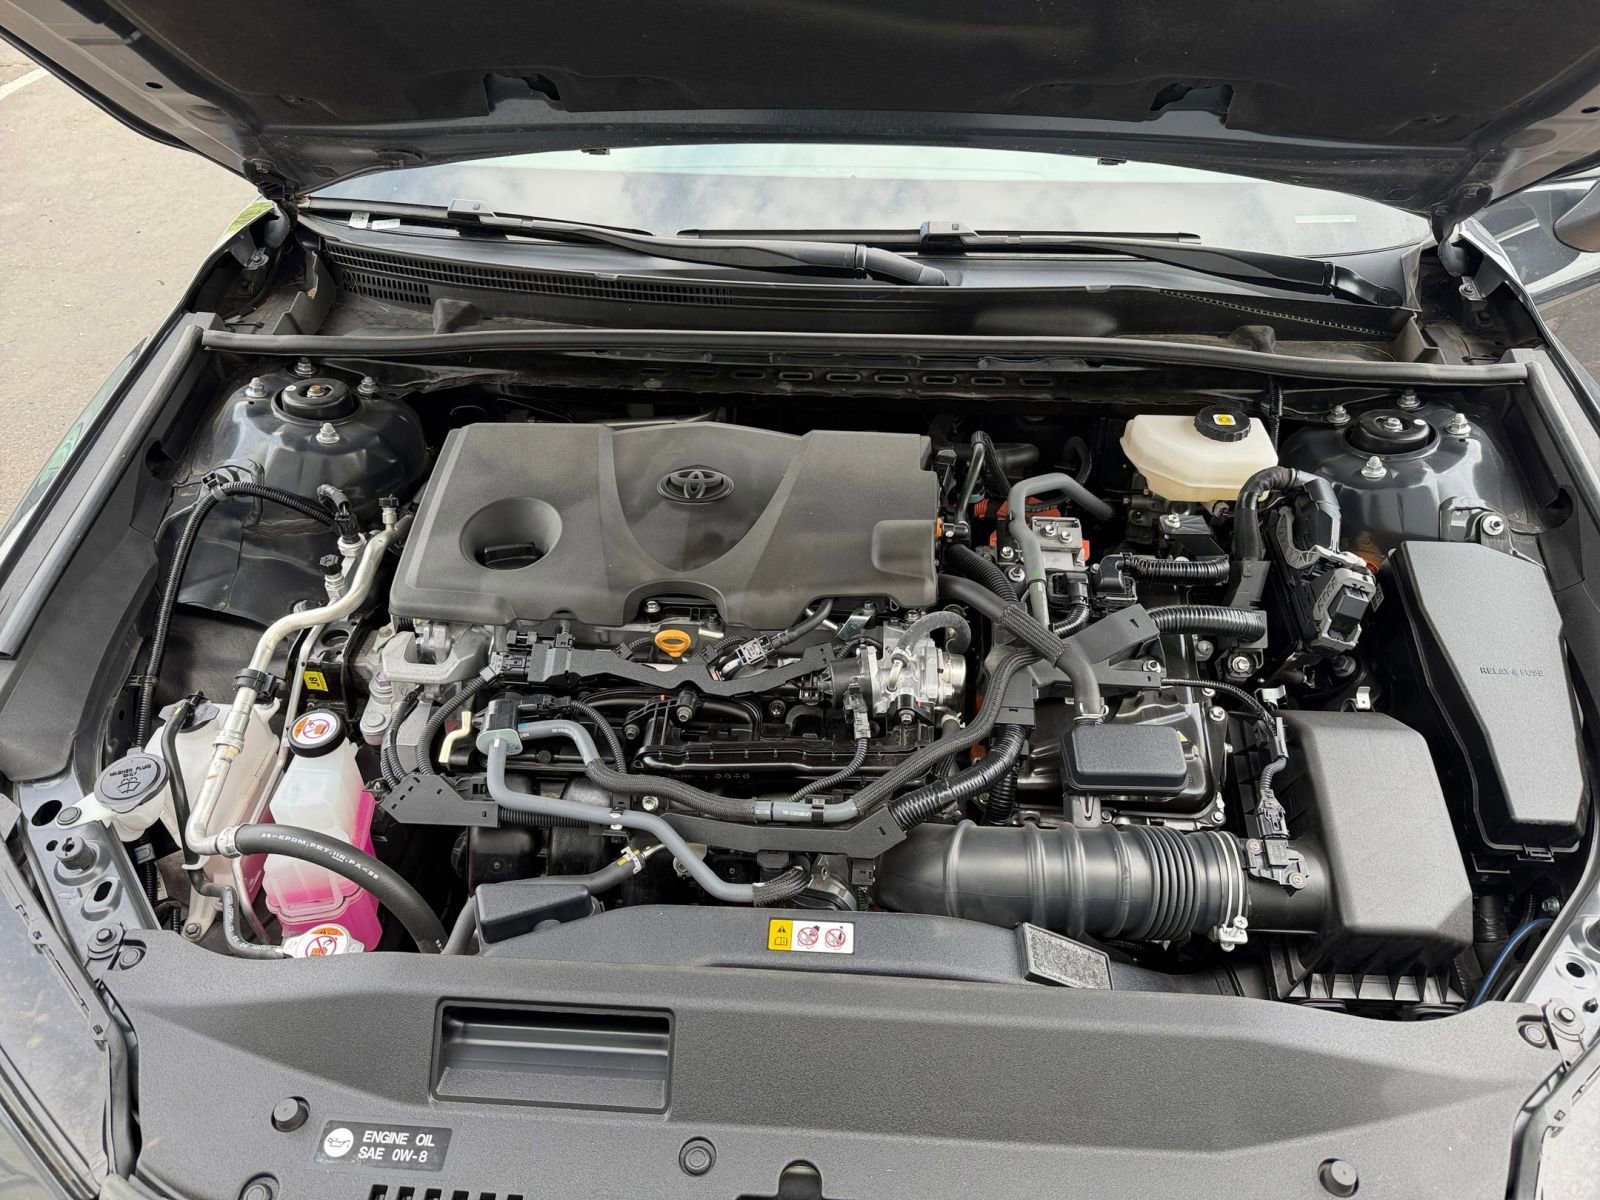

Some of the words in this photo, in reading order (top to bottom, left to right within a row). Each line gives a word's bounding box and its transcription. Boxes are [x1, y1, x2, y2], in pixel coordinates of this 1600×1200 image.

[1479, 666, 1509, 676] RELAY
[362, 1130, 410, 1146] ENGINE
[415, 1133, 436, 1147] OIL
[357, 1146, 386, 1160] SAE
[391, 1148, 428, 1163] 0W-8
